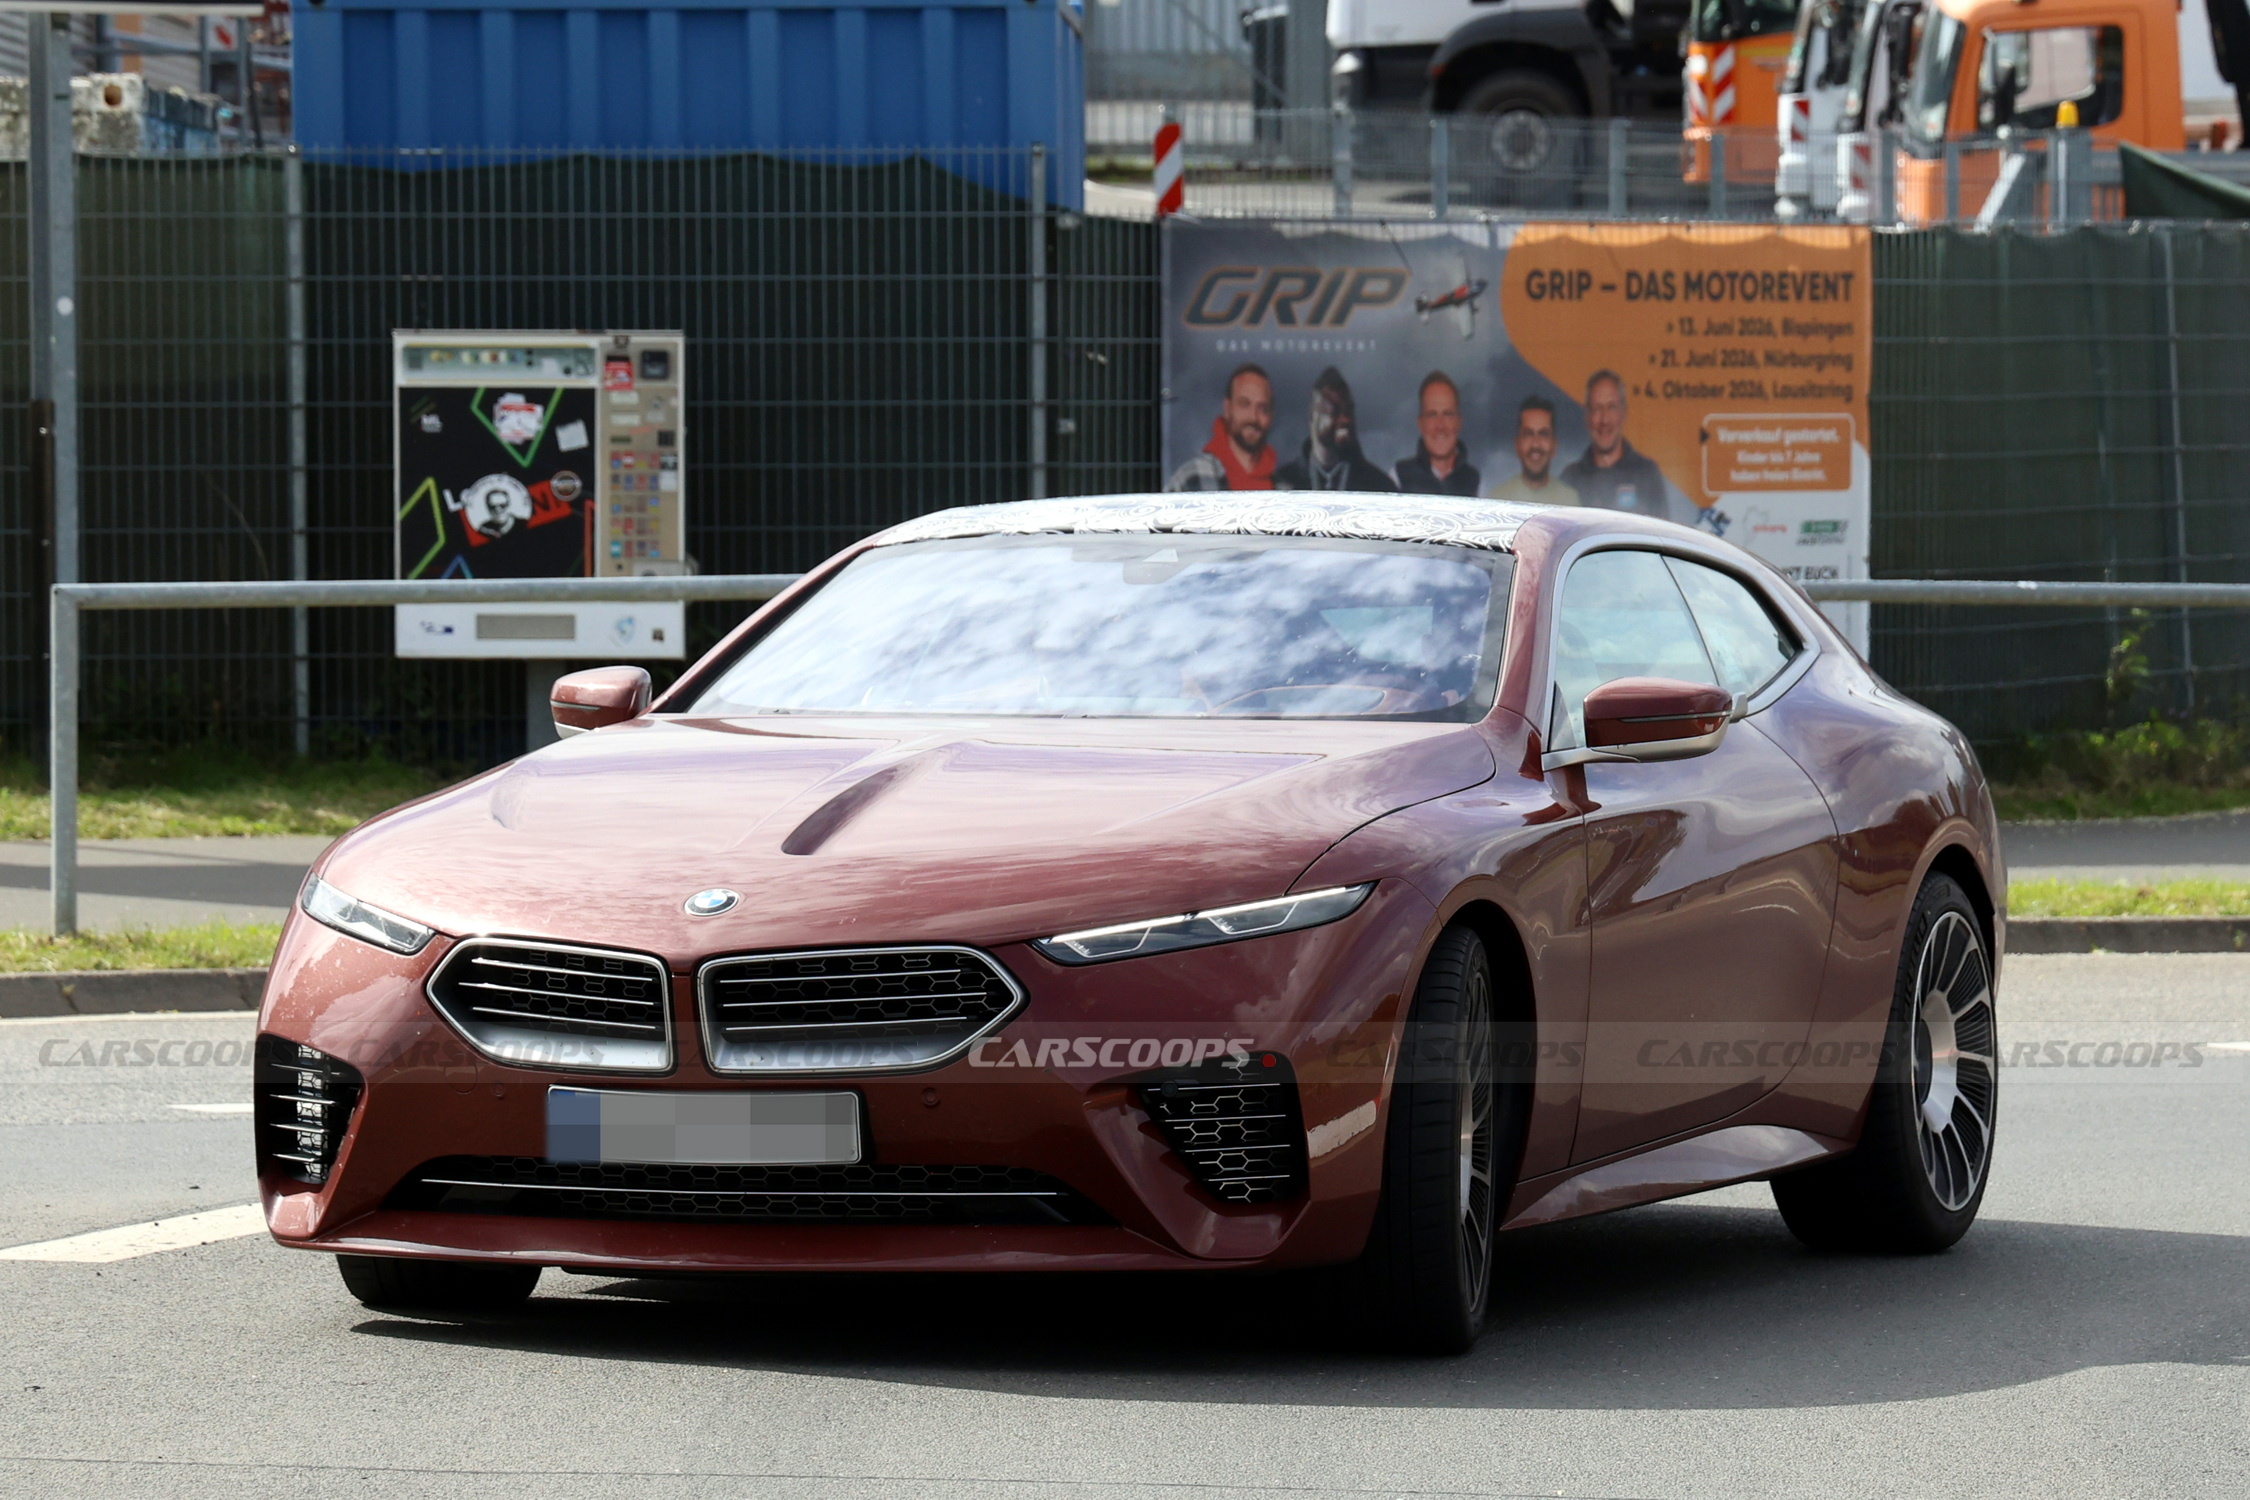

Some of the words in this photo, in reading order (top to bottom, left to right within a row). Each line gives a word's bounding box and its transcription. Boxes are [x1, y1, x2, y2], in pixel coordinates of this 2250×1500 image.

[1182, 266, 1411, 328] GRIP
[1525, 269, 1593, 300] GRIP
[1625, 270, 1676, 300] DAS
[1684, 270, 1854, 300] MOTOREVENT
[1704, 316, 1735, 336] Juni
[1685, 348, 1717, 368] Juni
